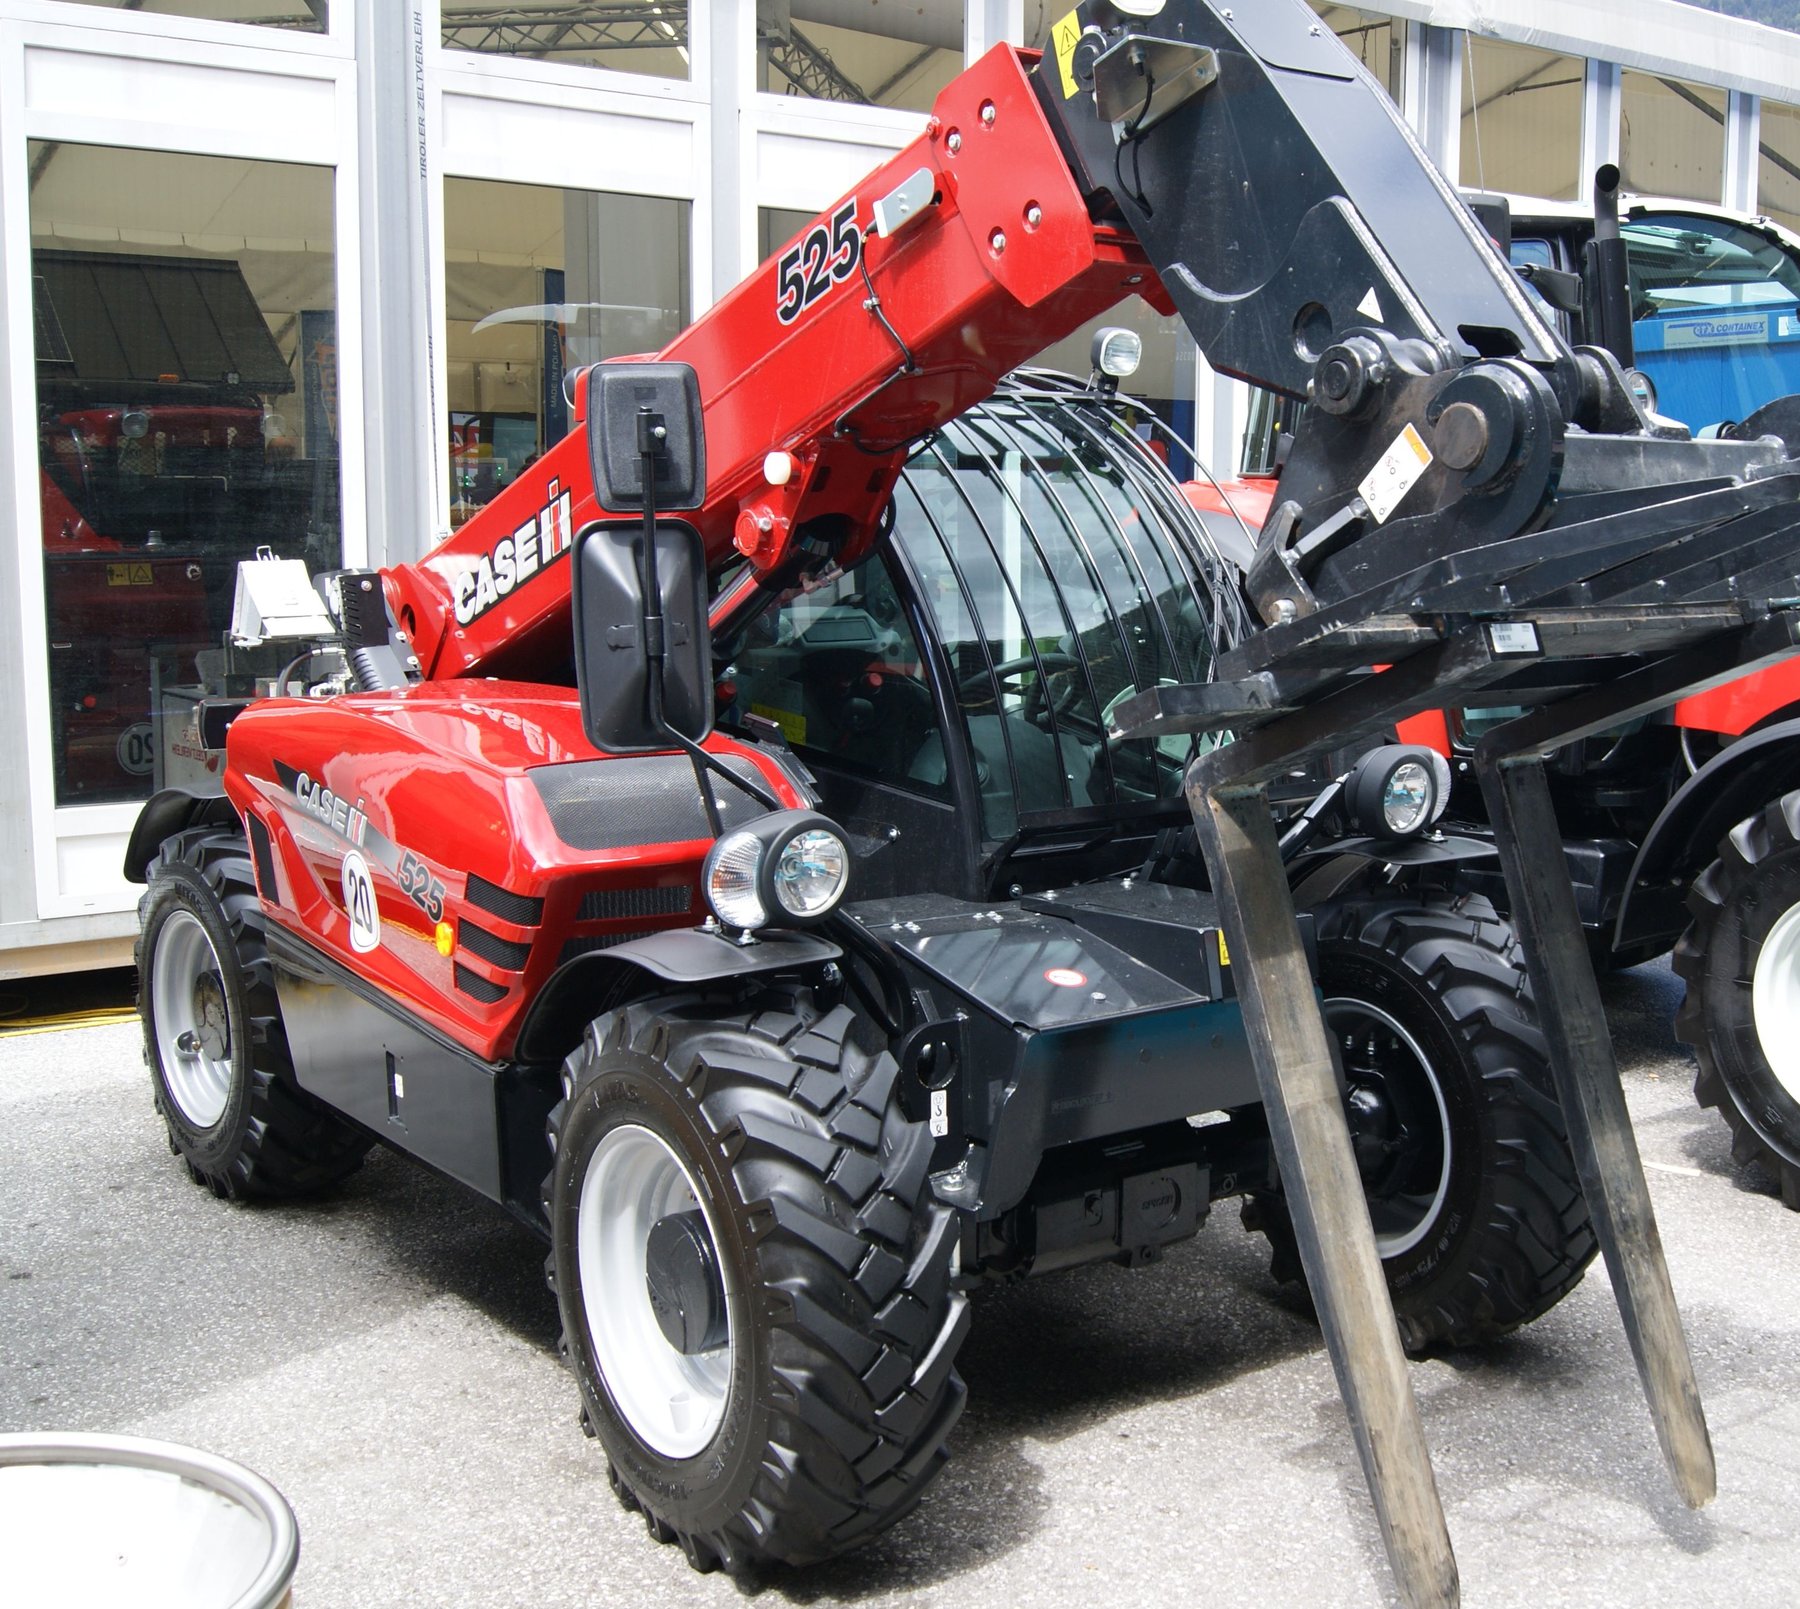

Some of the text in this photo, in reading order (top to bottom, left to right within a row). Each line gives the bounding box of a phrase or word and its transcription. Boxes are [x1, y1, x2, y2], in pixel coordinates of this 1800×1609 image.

[413, 11, 428, 180] TIROLER ZELTVERLEIH
[777, 196, 861, 325] 525
[1716, 320, 1766, 333] CONTAINEX
[454, 517, 539, 625] CASE
[296, 772, 349, 834] CASE
[348, 869, 373, 934] 20
[399, 849, 447, 923] 525
